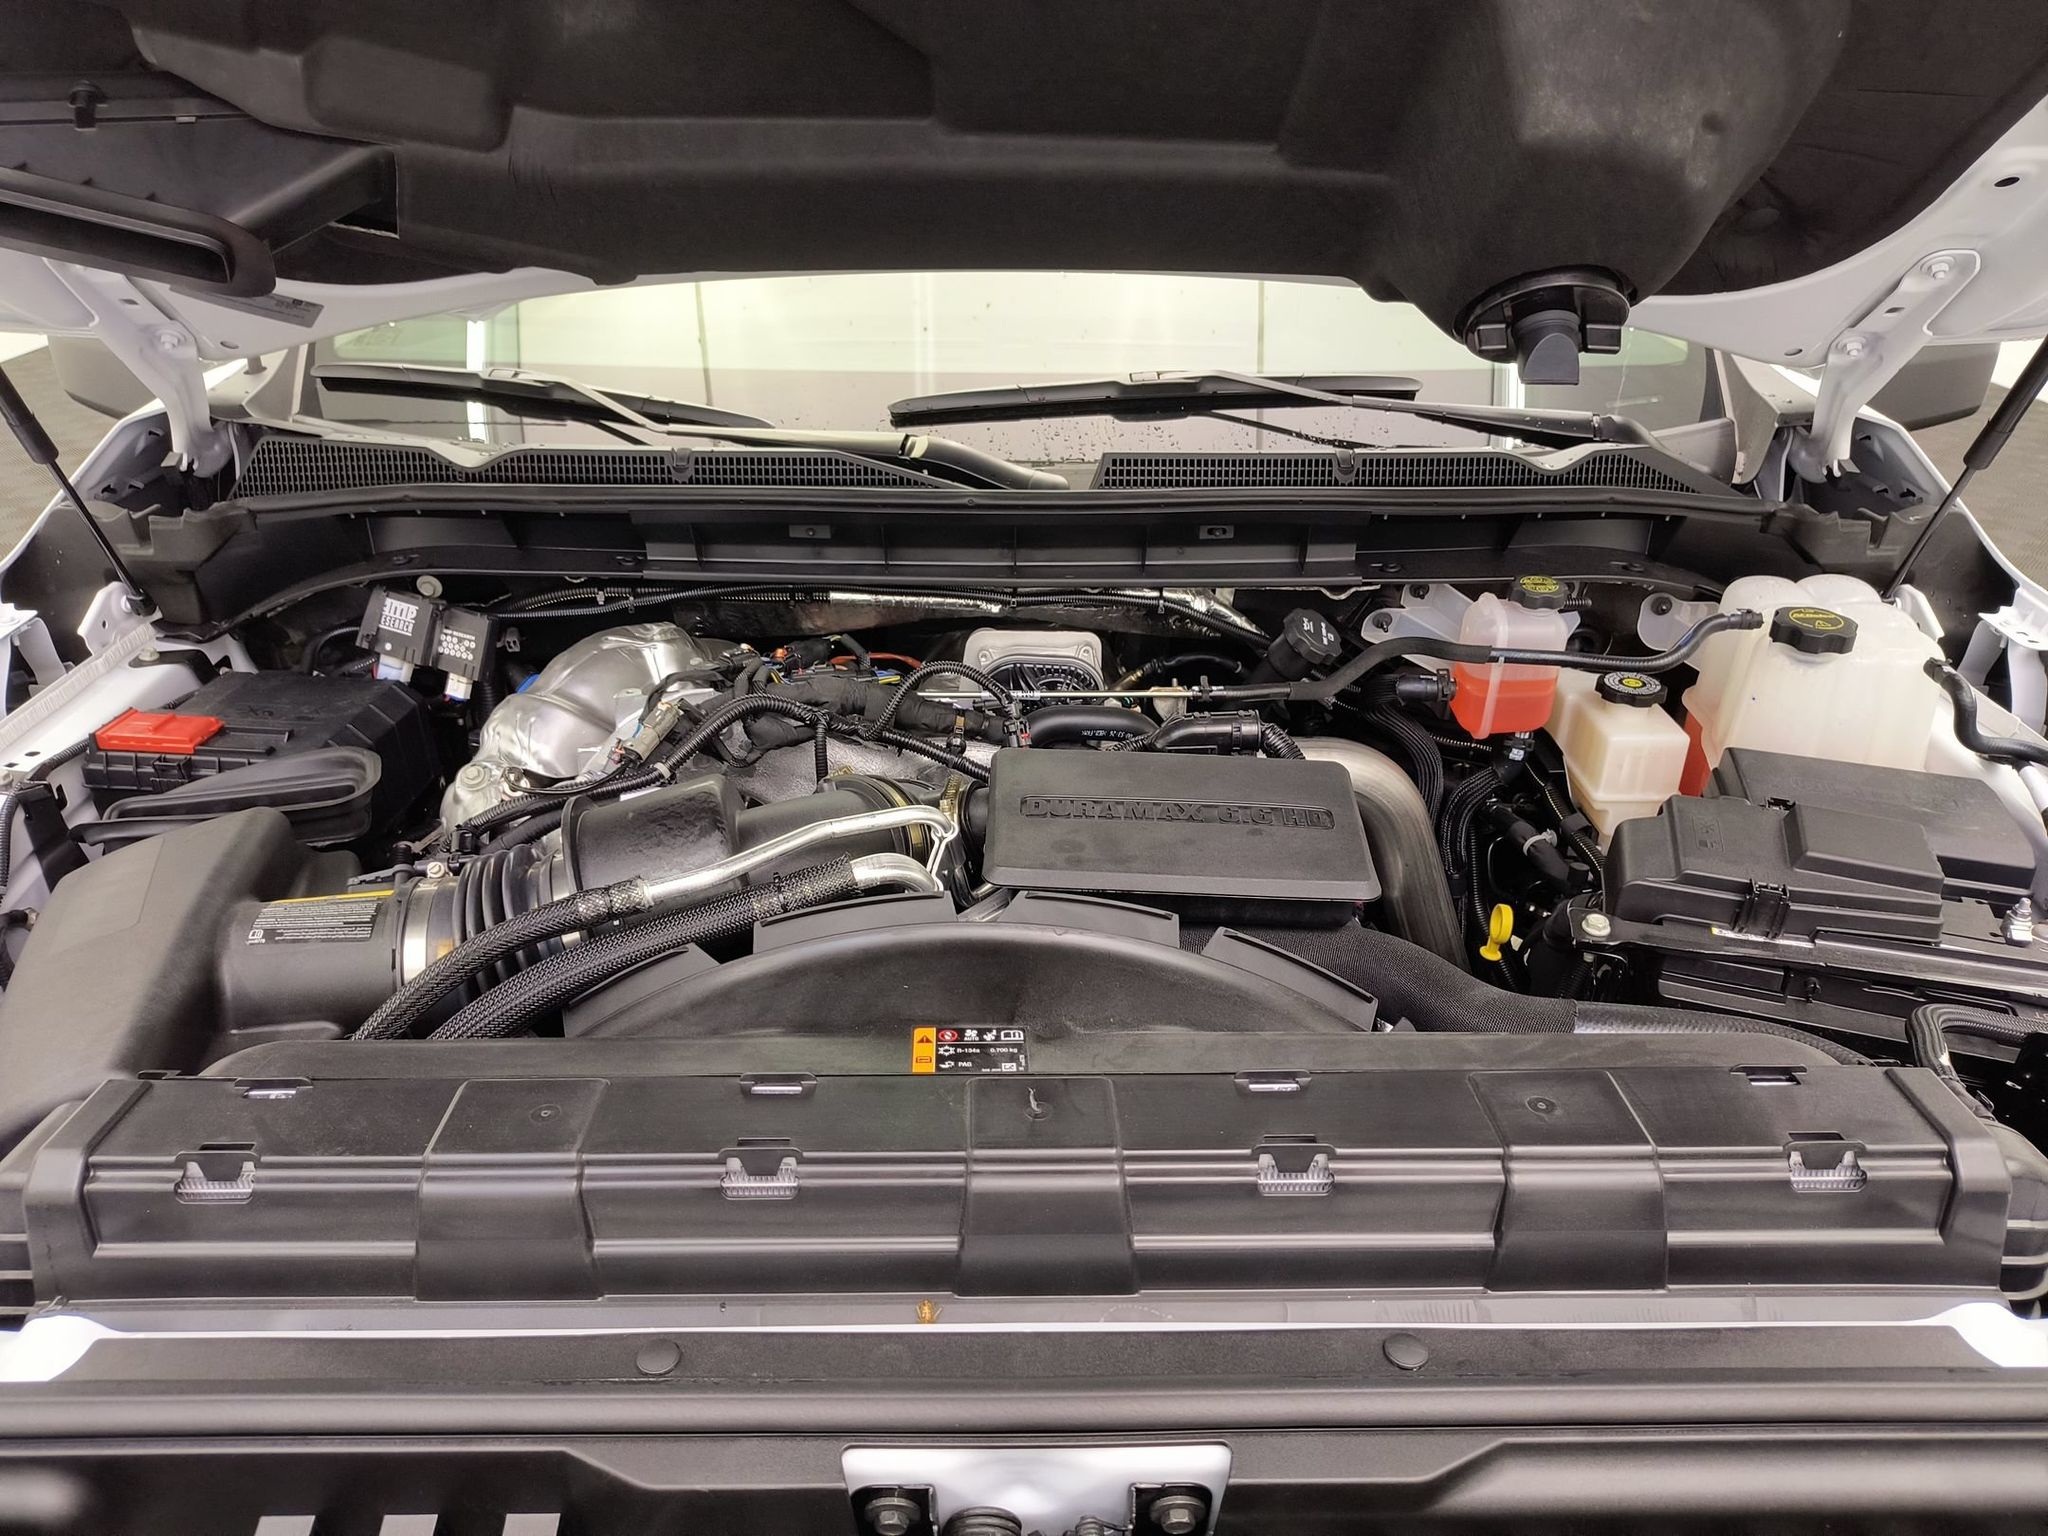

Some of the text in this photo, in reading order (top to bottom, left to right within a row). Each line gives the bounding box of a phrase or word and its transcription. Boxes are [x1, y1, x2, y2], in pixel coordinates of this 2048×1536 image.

[1025, 798, 1333, 830] DURAMAX 6.6 HD
